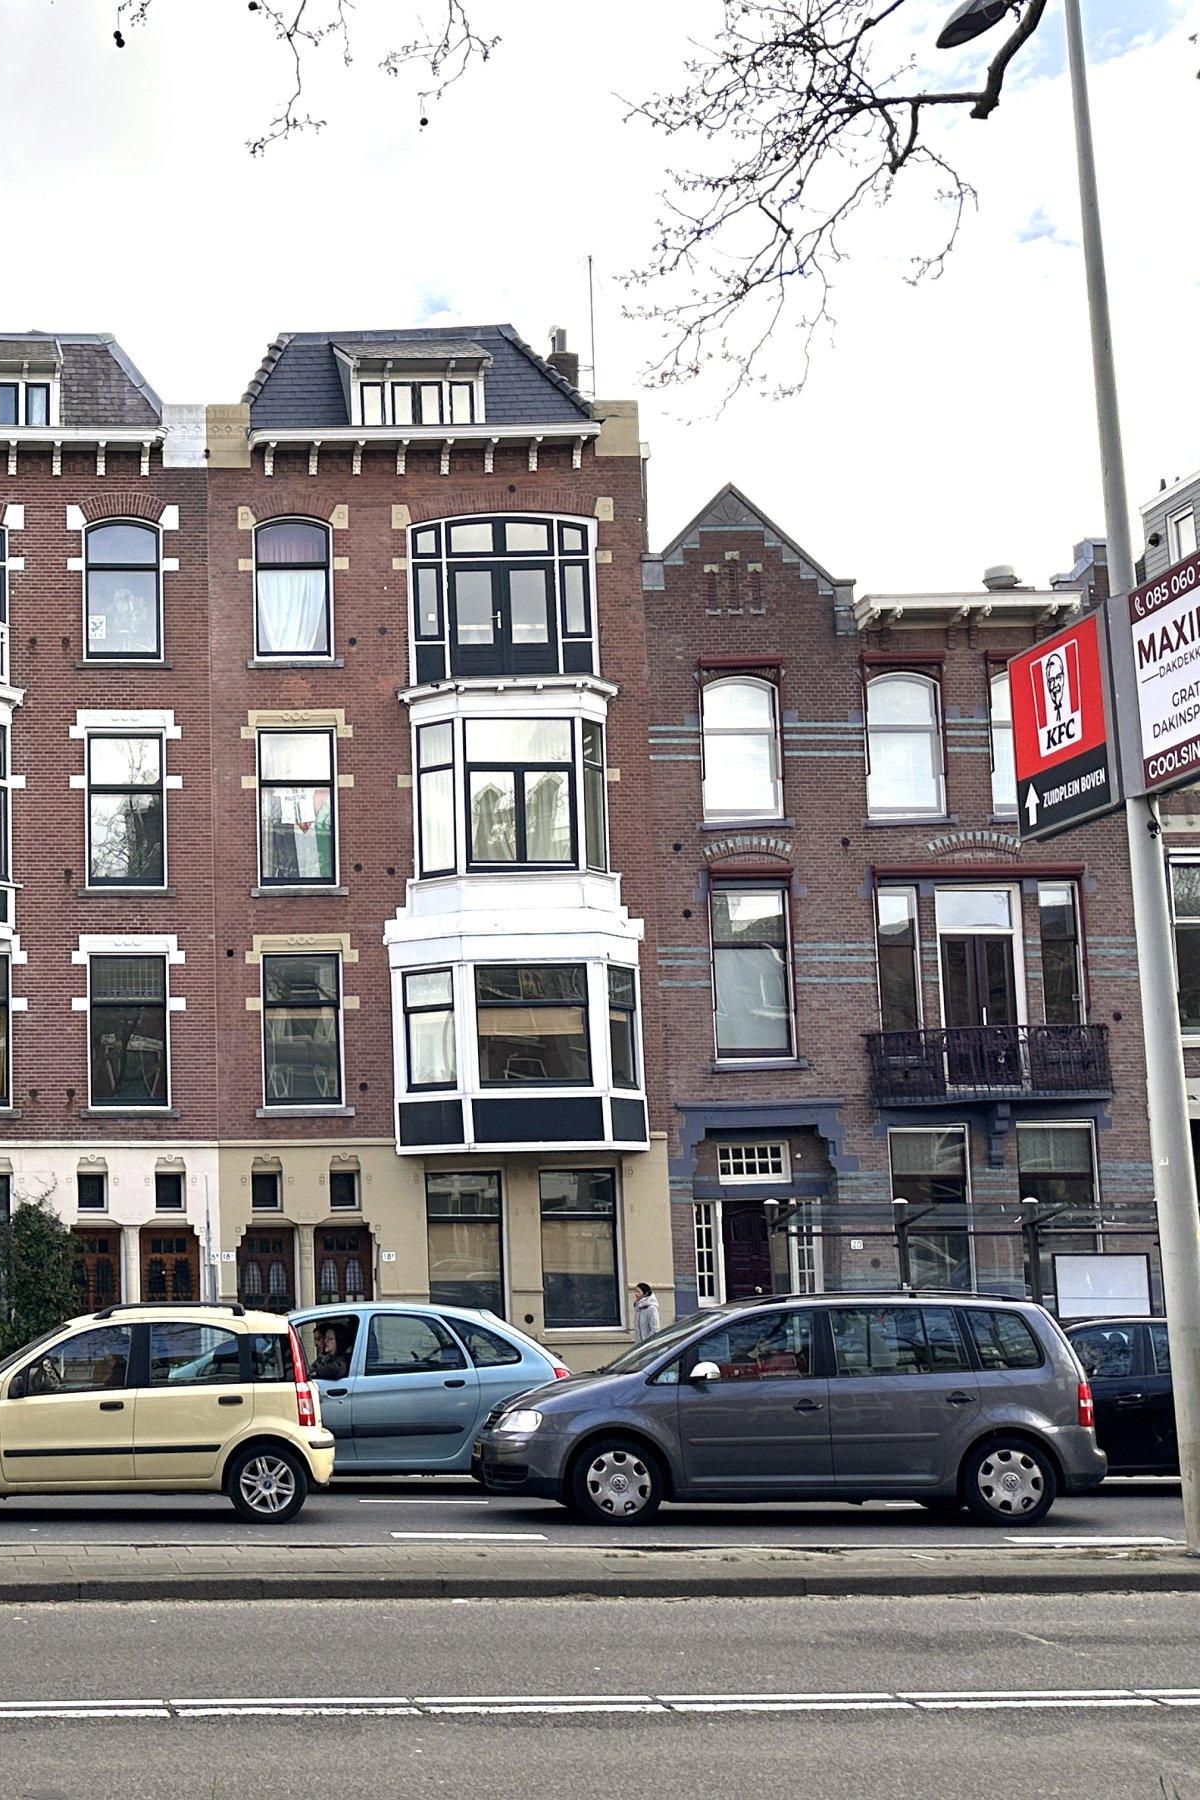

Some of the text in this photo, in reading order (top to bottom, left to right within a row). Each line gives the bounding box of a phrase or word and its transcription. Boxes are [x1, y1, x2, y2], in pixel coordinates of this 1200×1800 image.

[1146, 581, 1169, 610] 085
[1171, 565, 1195, 594] 060
[1172, 680, 1200, 707] GRAT
[1046, 717, 1075, 750] KFC
[1153, 704, 1200, 738] DAKINSP
[1148, 740, 1200, 779] COOLSIN
[1043, 767, 1106, 808] ZUIDPLEIN BOVEN
